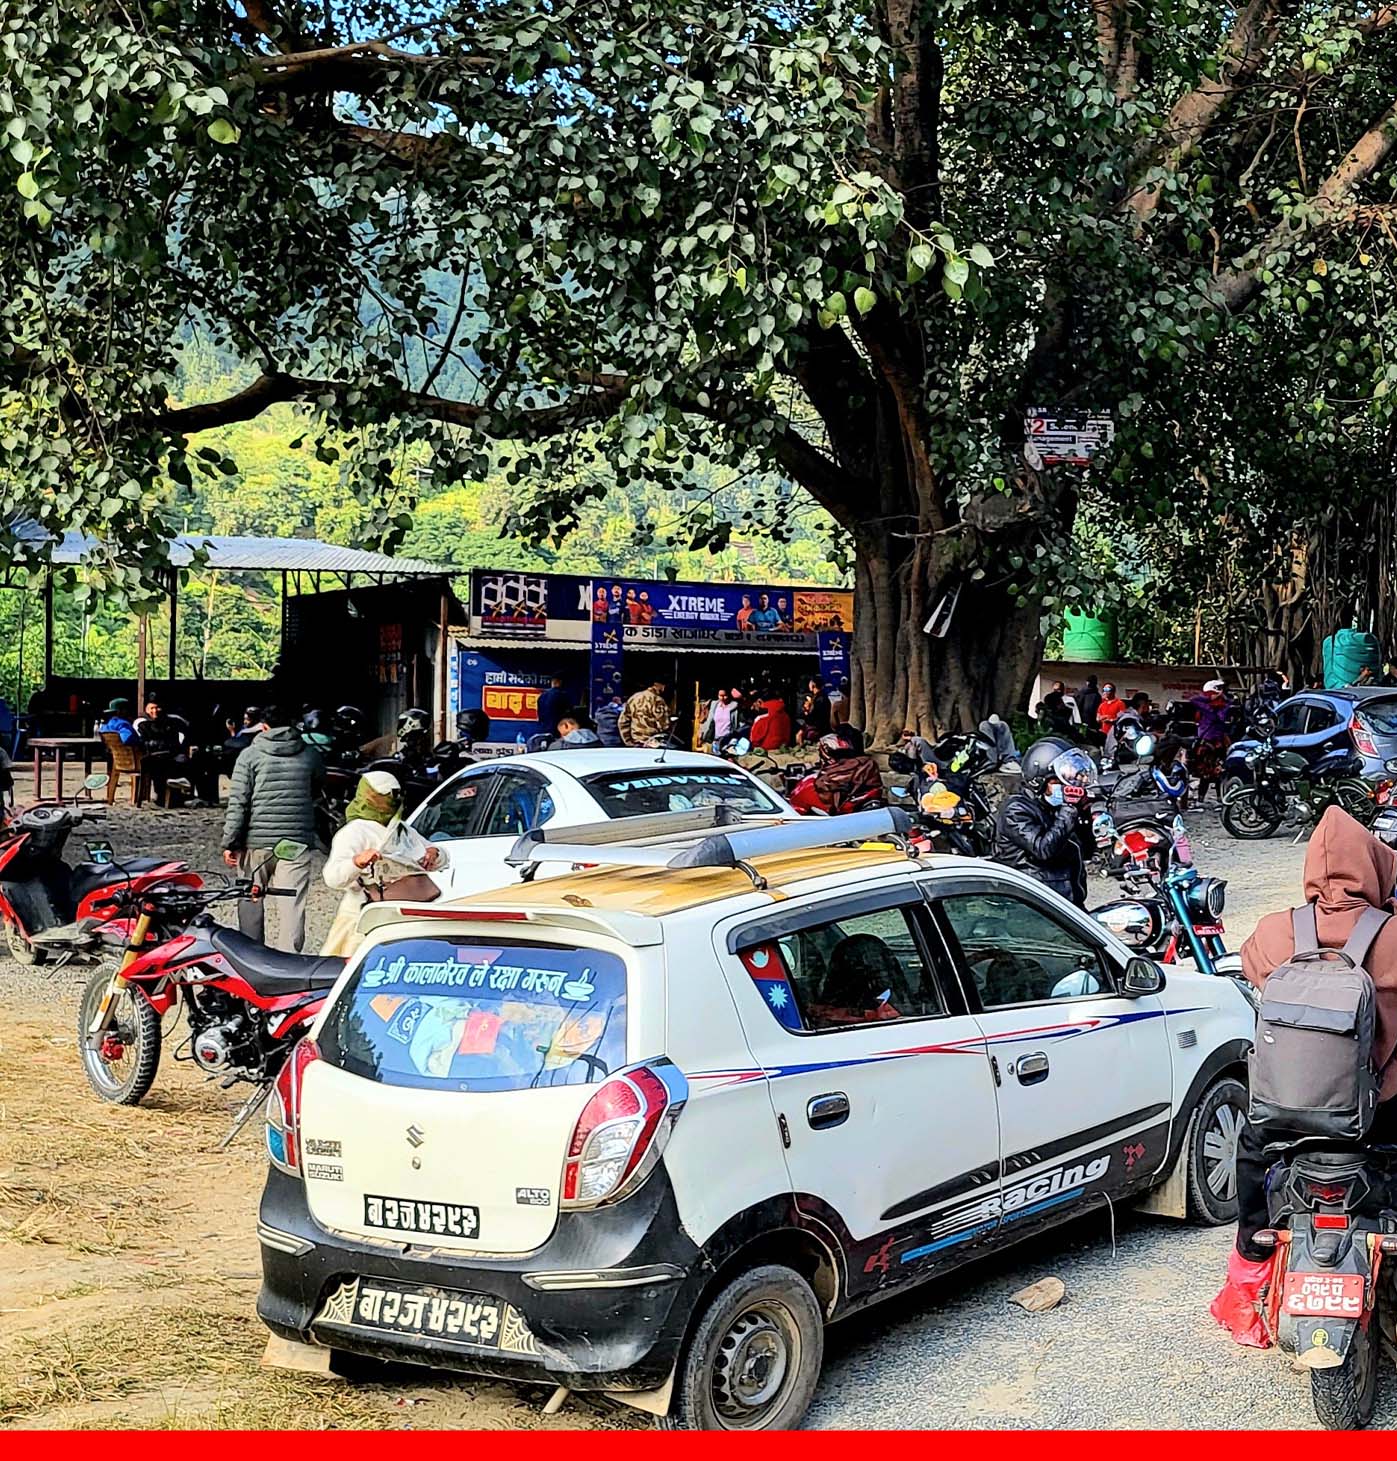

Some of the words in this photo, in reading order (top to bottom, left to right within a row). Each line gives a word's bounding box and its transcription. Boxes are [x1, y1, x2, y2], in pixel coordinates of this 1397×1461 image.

[668, 595, 725, 612] XTREME
[608, 775, 742, 791] VEDVYAS
[469, 960, 489, 989] ले
[490, 965, 524, 992] रक्षा
[517, 1189, 549, 1199] ALTO
[979, 1154, 1112, 1220] Racing
